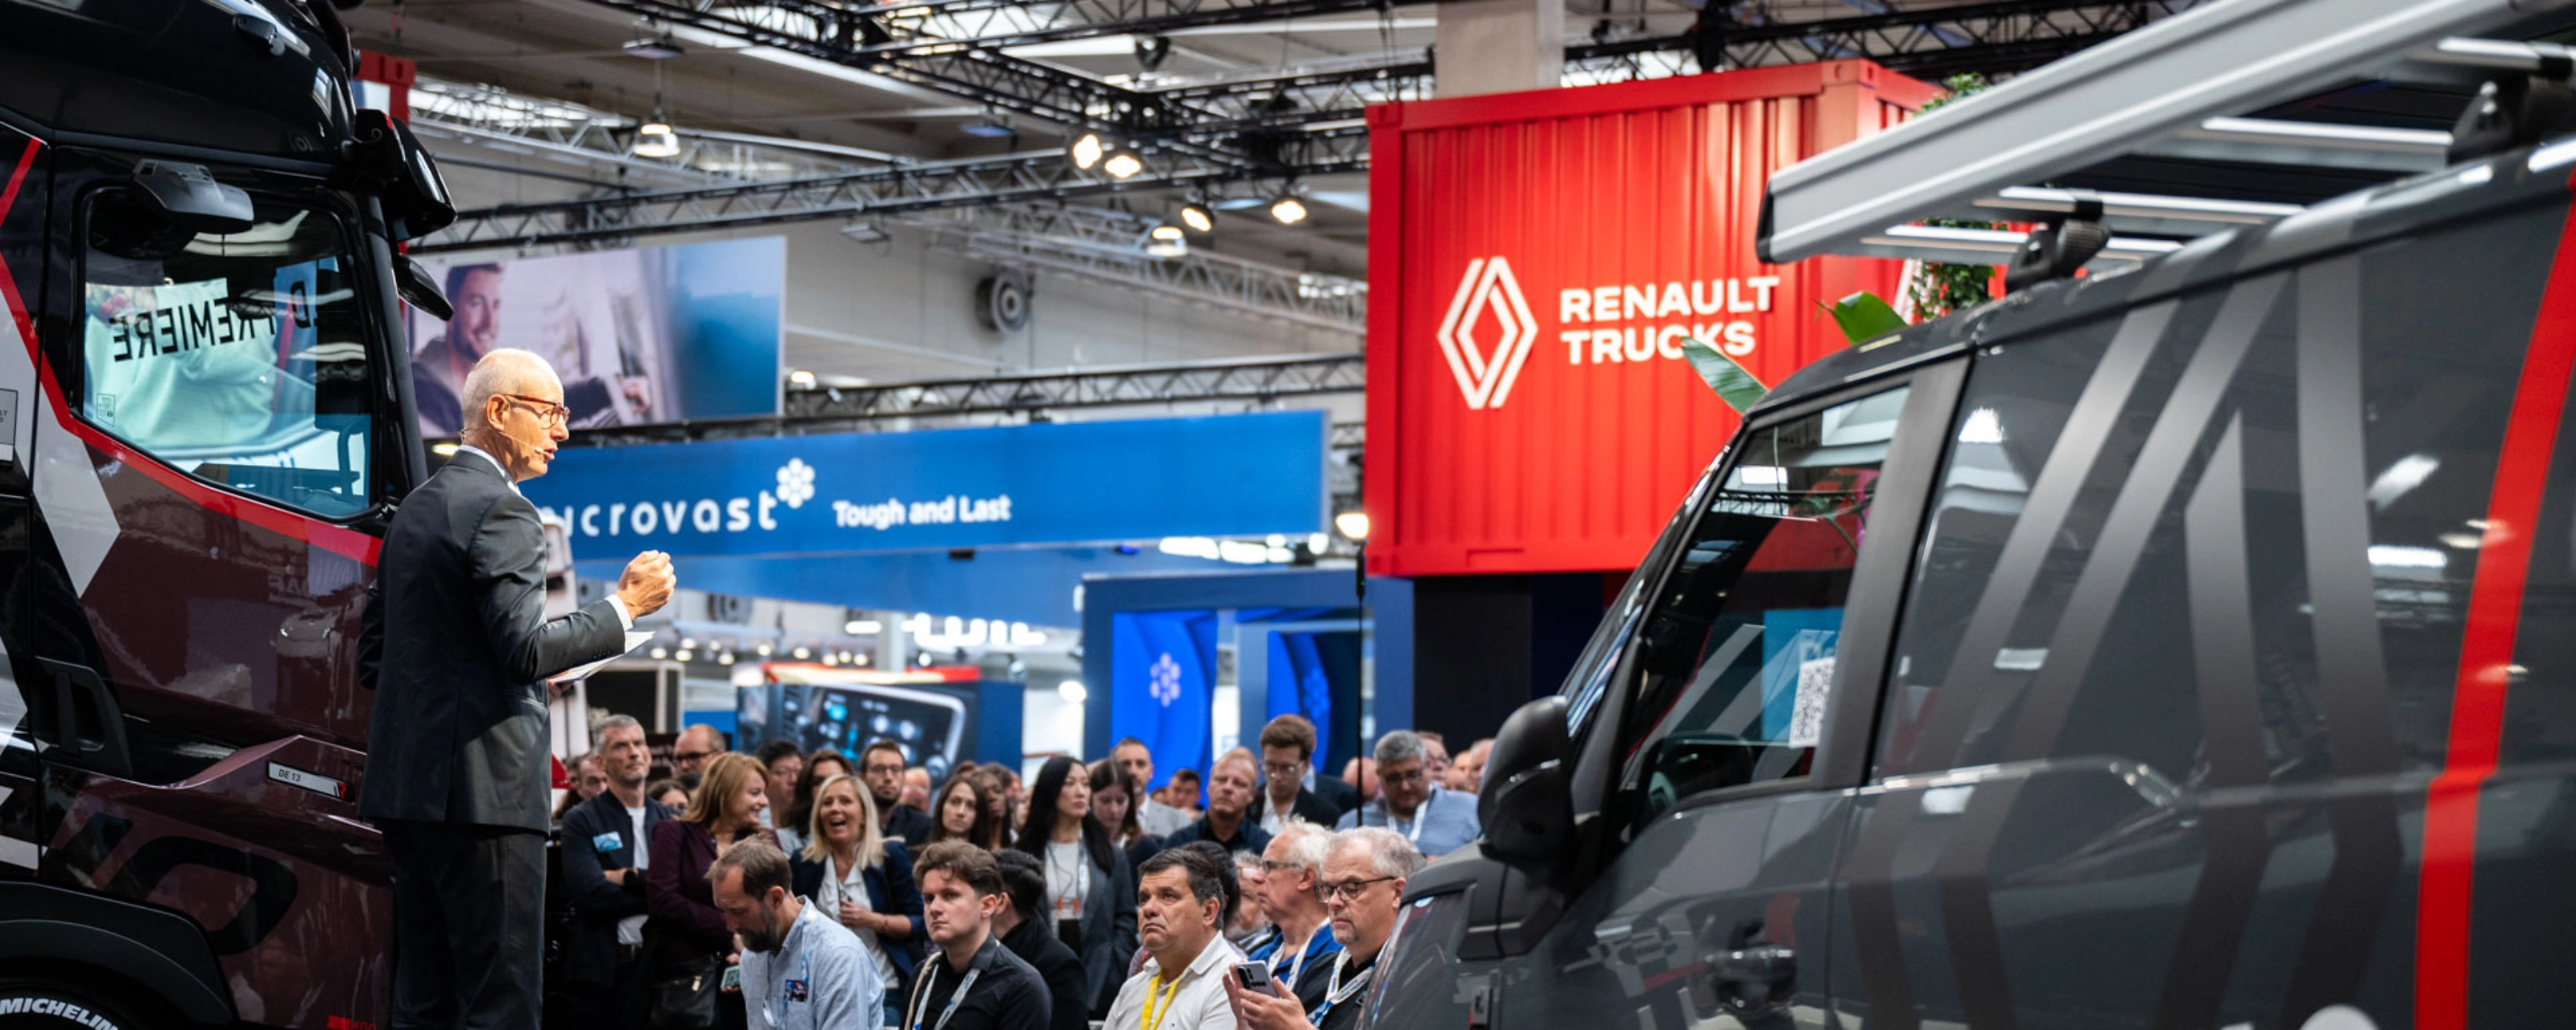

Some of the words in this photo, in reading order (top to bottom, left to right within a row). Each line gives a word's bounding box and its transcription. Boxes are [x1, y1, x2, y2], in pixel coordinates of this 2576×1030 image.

[1560, 275, 1781, 323] RENAULT
[1560, 320, 1756, 365] TRUCKS
[537, 490, 778, 538] icrovast
[832, 497, 906, 530] Tough
[908, 495, 956, 524] and
[959, 494, 1012, 522] Last
[279, 769, 289, 780] DE
[291, 773, 301, 783] 13
[0, 997, 118, 1030] MICHELIN
